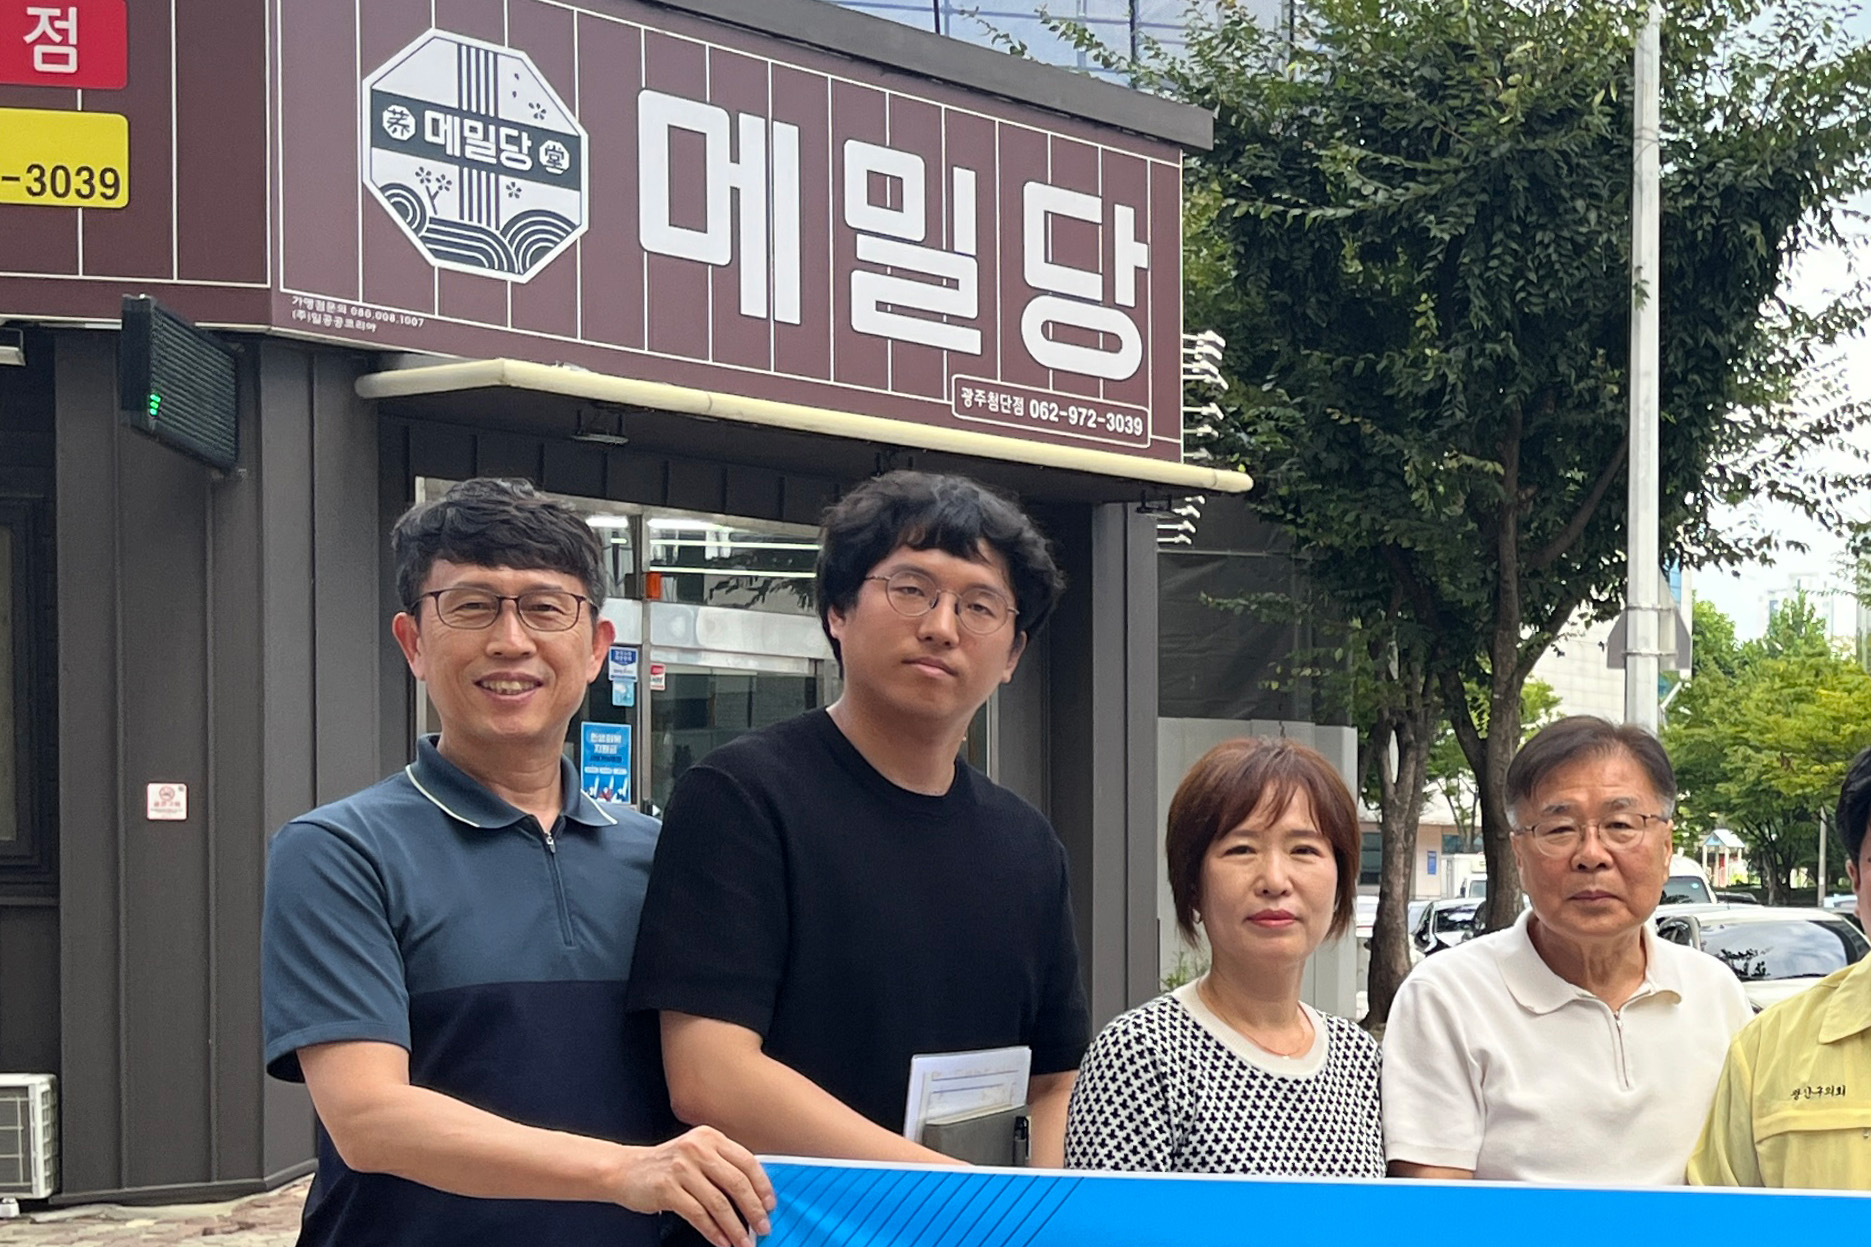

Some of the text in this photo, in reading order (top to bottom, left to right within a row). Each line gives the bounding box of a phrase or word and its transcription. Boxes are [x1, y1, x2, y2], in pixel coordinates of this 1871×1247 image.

[24, 5, 78, 73] 점
[424, 109, 532, 169] 메밀당
[0, 164, 121, 201] -3039
[638, 88, 1149, 381] 메밀당
[960, 387, 1143, 436] 광주첨단점 062-972-3039
